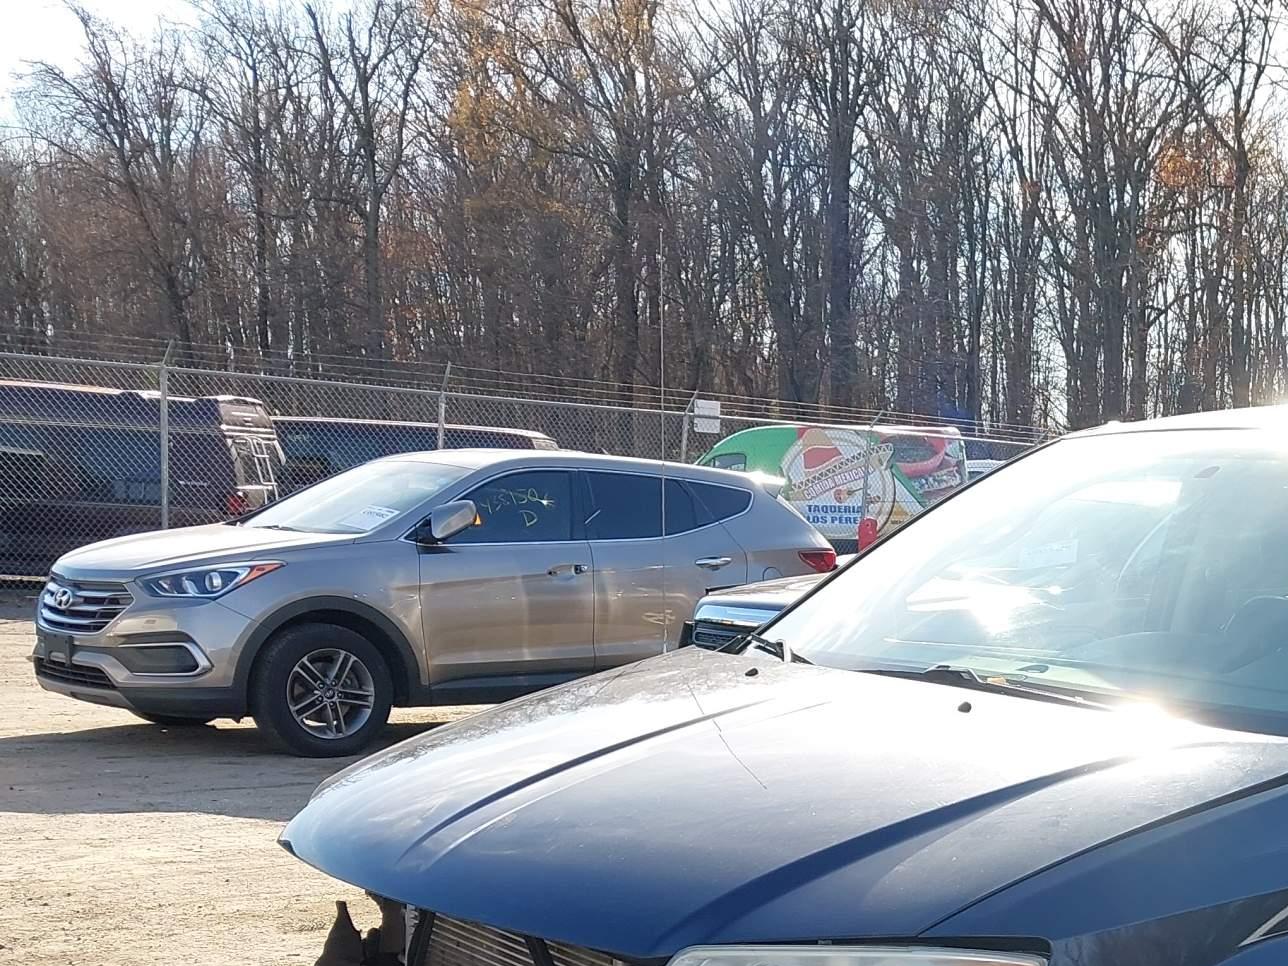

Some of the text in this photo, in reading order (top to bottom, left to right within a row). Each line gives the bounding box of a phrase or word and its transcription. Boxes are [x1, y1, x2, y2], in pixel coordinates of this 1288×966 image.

[803, 466, 876, 499] COMIDA MEXICAA
[806, 515, 861, 525] LOS PERE
